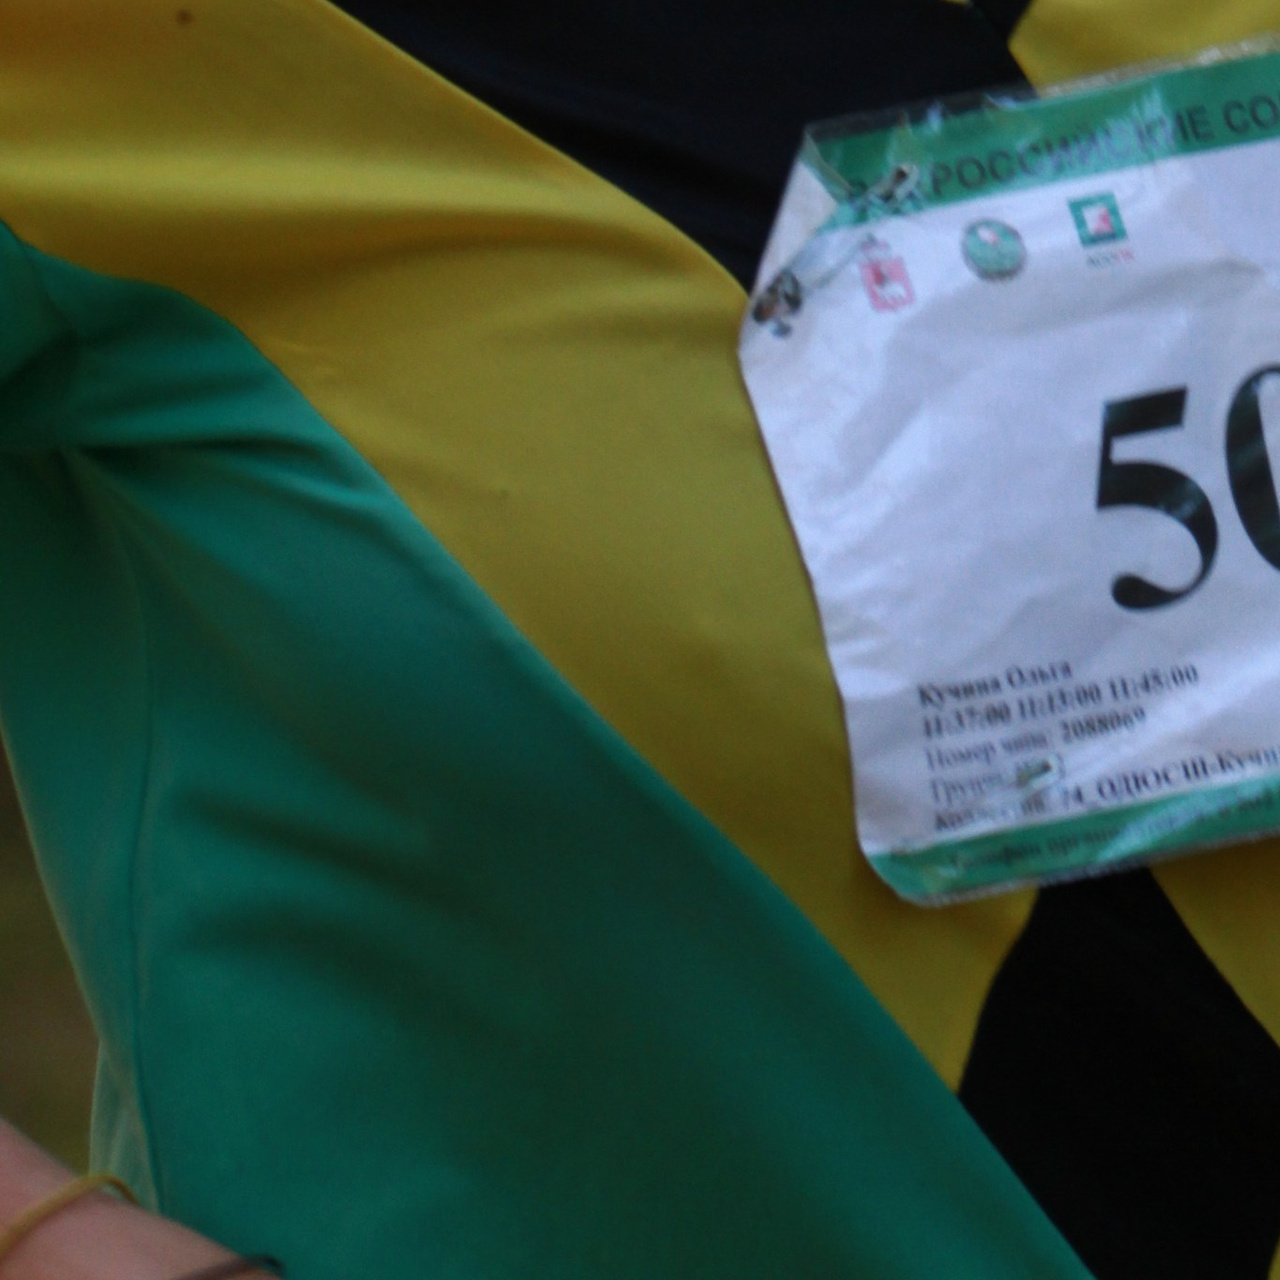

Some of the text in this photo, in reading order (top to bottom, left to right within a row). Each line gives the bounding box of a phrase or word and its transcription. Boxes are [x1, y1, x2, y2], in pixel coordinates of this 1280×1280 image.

[918, 661, 1072, 708] Кучина Ольга
[1060, 704, 1146, 744] 2088069
